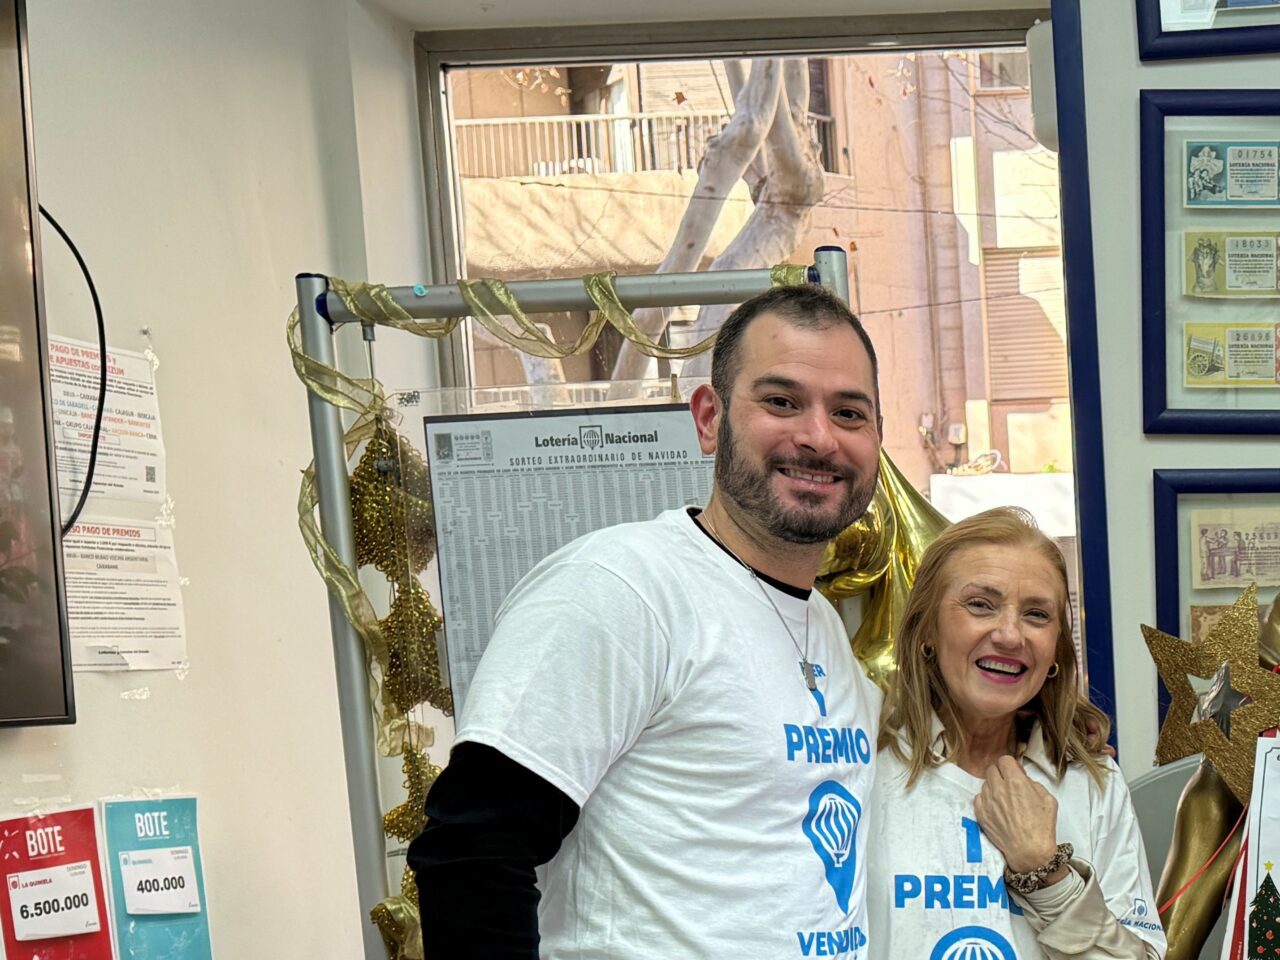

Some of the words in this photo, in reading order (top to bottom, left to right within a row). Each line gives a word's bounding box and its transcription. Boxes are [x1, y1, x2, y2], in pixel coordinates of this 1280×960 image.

[534, 434, 579, 448] Lotería
[604, 430, 659, 445] Nacional
[510, 456, 543, 467] SORTEO
[548, 452, 626, 466] EXTRAORDINARIO
[632, 452, 643, 461] DE
[648, 450, 688, 460] NAVIDAD
[82, 526, 100, 536] PAGO
[102, 526, 111, 536] DE
[112, 527, 141, 538] PREMIOS
[784, 723, 871, 765] PREMIO
[134, 811, 170, 838] BOTE
[26, 826, 65, 857] BOTE
[136, 876, 186, 894] 400.000
[894, 874, 1024, 916] PREM
[20, 892, 89, 920] 6.500.000
